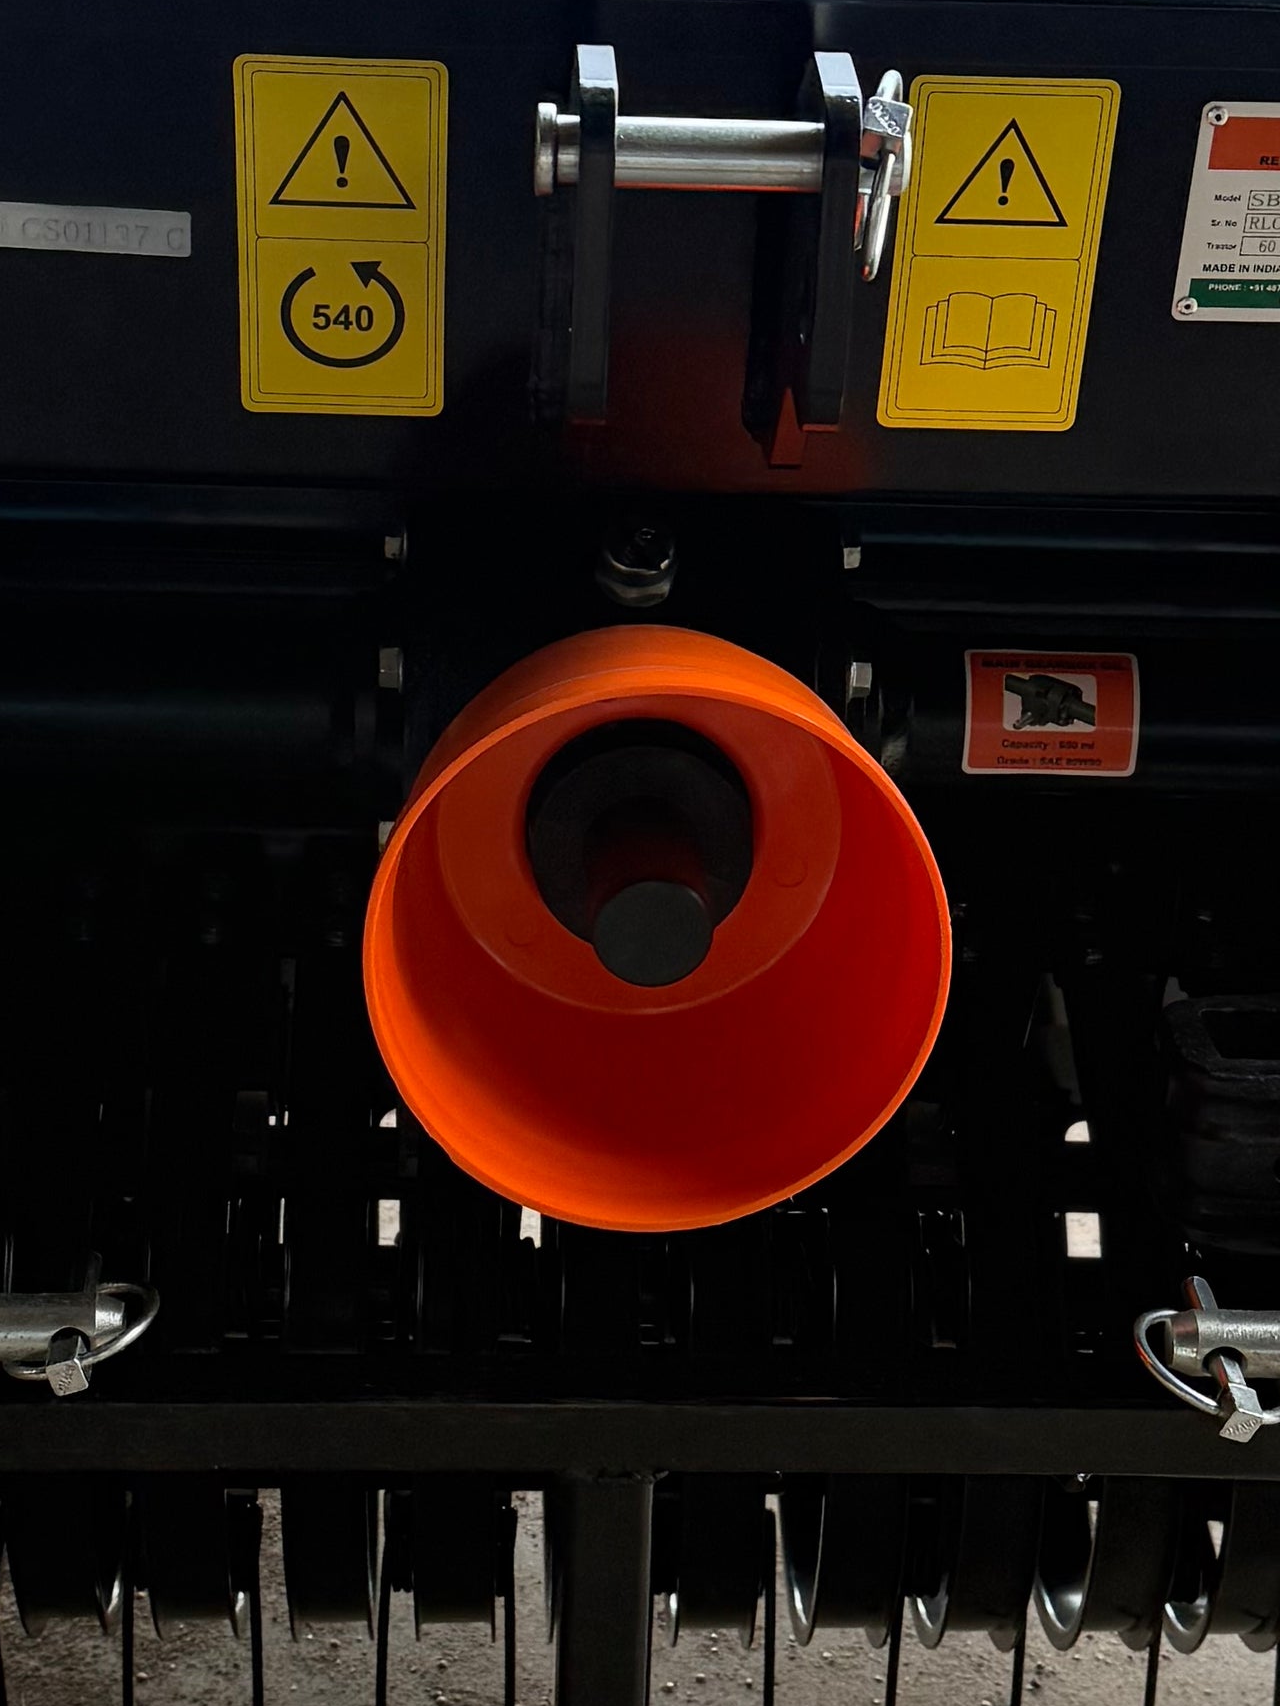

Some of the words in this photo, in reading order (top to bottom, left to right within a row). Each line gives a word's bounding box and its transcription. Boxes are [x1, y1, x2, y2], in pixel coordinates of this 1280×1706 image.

[1214, 194, 1241, 202] Model
[165, 226, 186, 251] C
[1258, 240, 1277, 253] 60
[1202, 263, 1235, 273] MADE
[1238, 264, 1250, 273] IN
[1208, 283, 1241, 291] PHONE
[310, 303, 375, 334] 540
